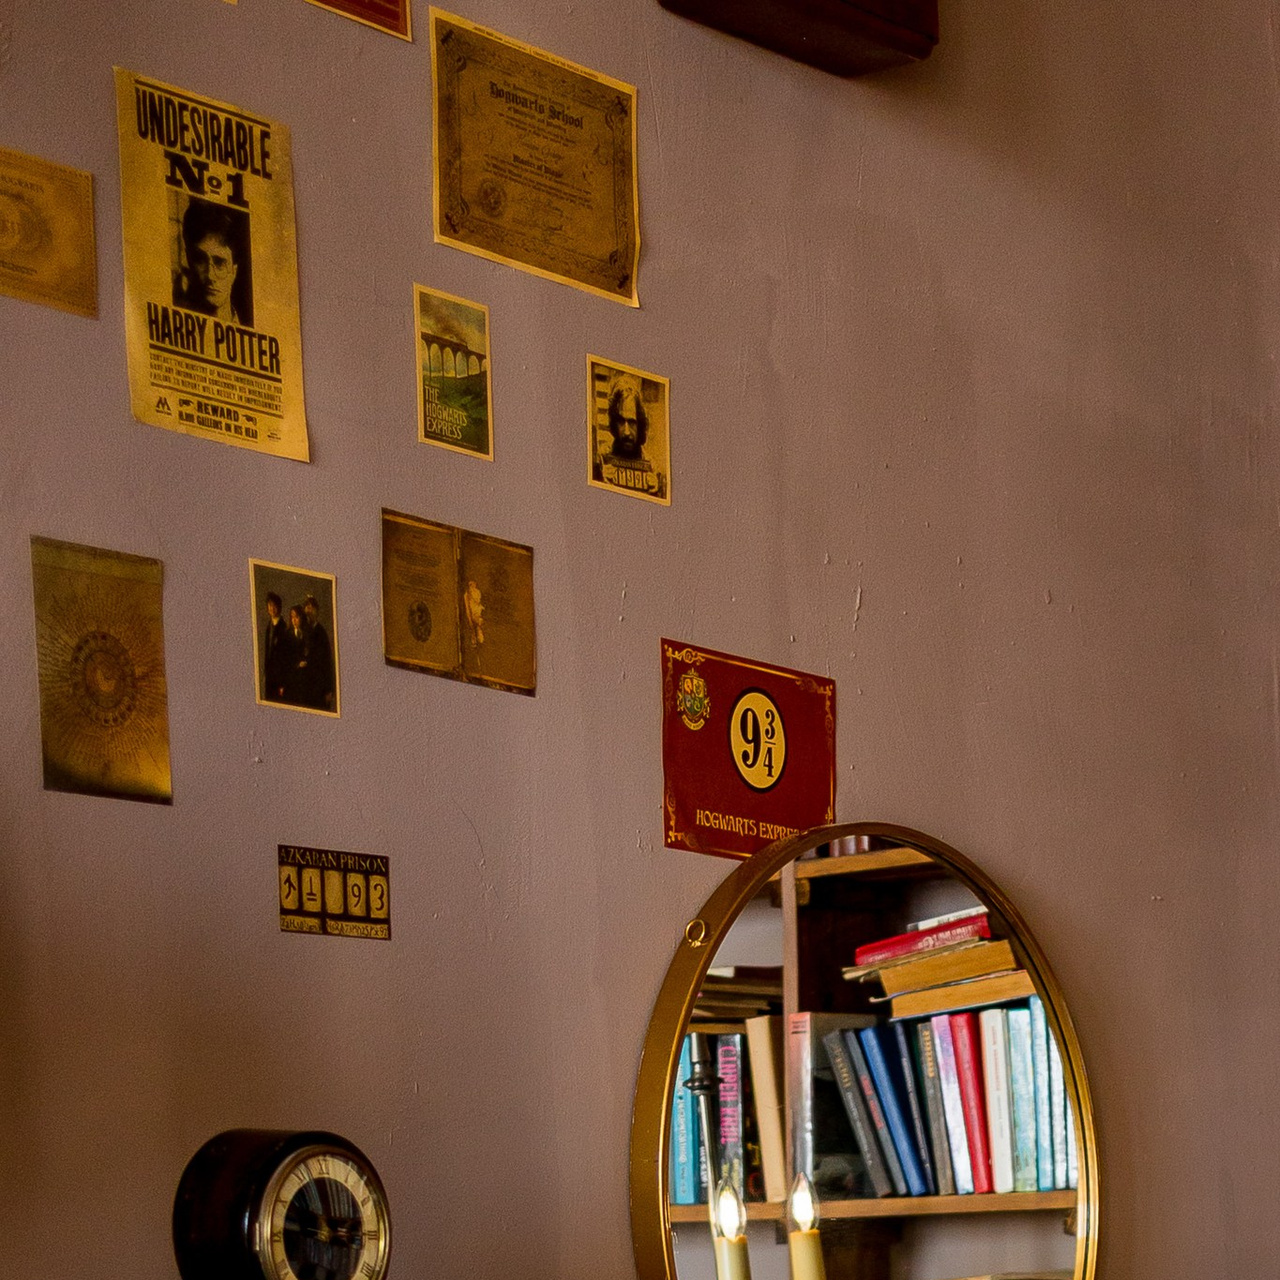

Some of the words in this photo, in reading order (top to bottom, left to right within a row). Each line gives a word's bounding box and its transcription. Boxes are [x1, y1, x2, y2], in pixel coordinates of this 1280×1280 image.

[135, 87, 272, 180] UNDESIRABLE
[147, 301, 207, 355] HARRY
[213, 320, 282, 375] POTTER
[424, 385, 440, 403] THE
[197, 400, 240, 422] REWARD
[426, 401, 467, 427] HOGWARTS
[426, 416, 462, 440] EXPRESS
[696, 809, 757, 837] HOGWARTS
[280, 848, 337, 868] AZKABAN
[340, 854, 386, 873] PRISON
